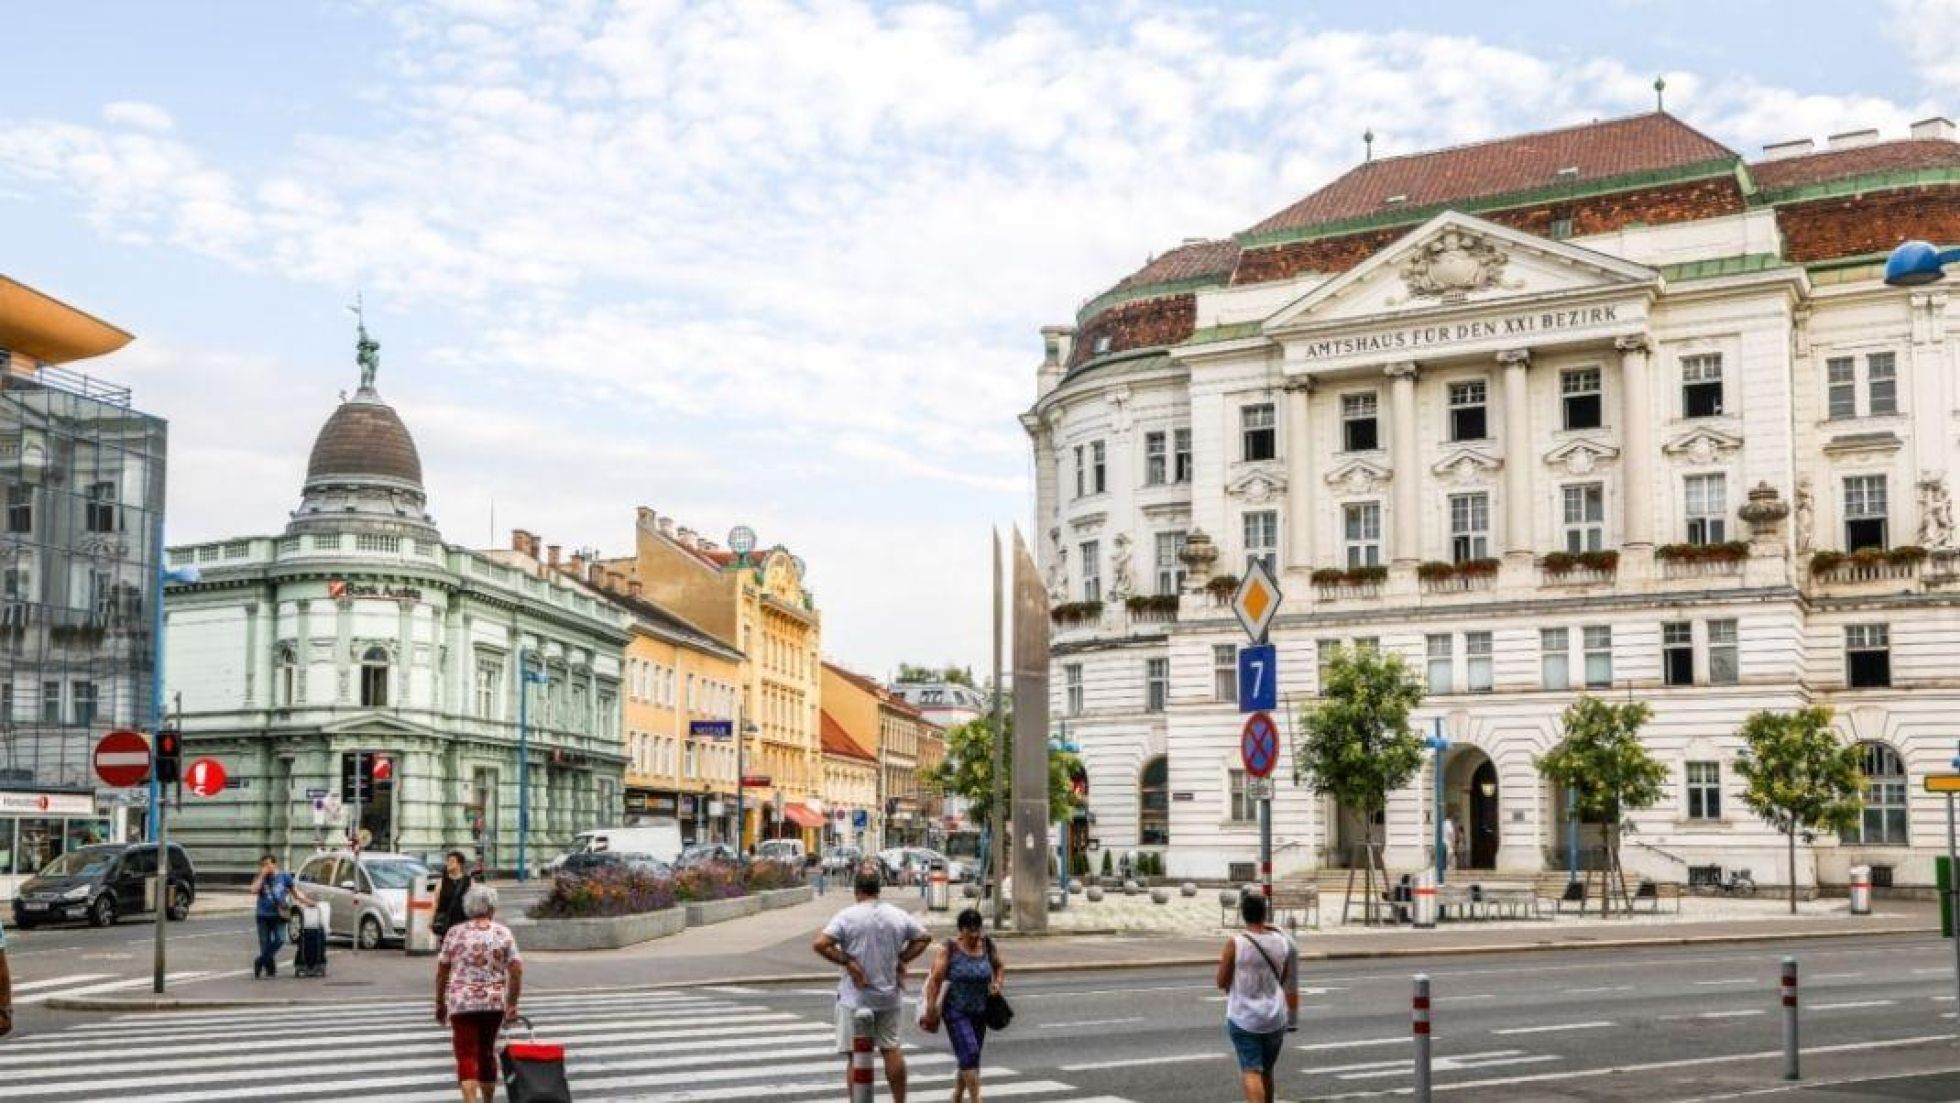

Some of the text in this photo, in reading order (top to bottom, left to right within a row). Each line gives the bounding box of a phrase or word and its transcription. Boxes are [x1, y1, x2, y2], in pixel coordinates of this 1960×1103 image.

[1306, 331, 1405, 358] AMTSHAUS
[1456, 322, 1497, 339] DEN
[1503, 315, 1534, 334] XXI
[1541, 305, 1617, 329] BEZIRK
[1251, 661, 1264, 699] 7
